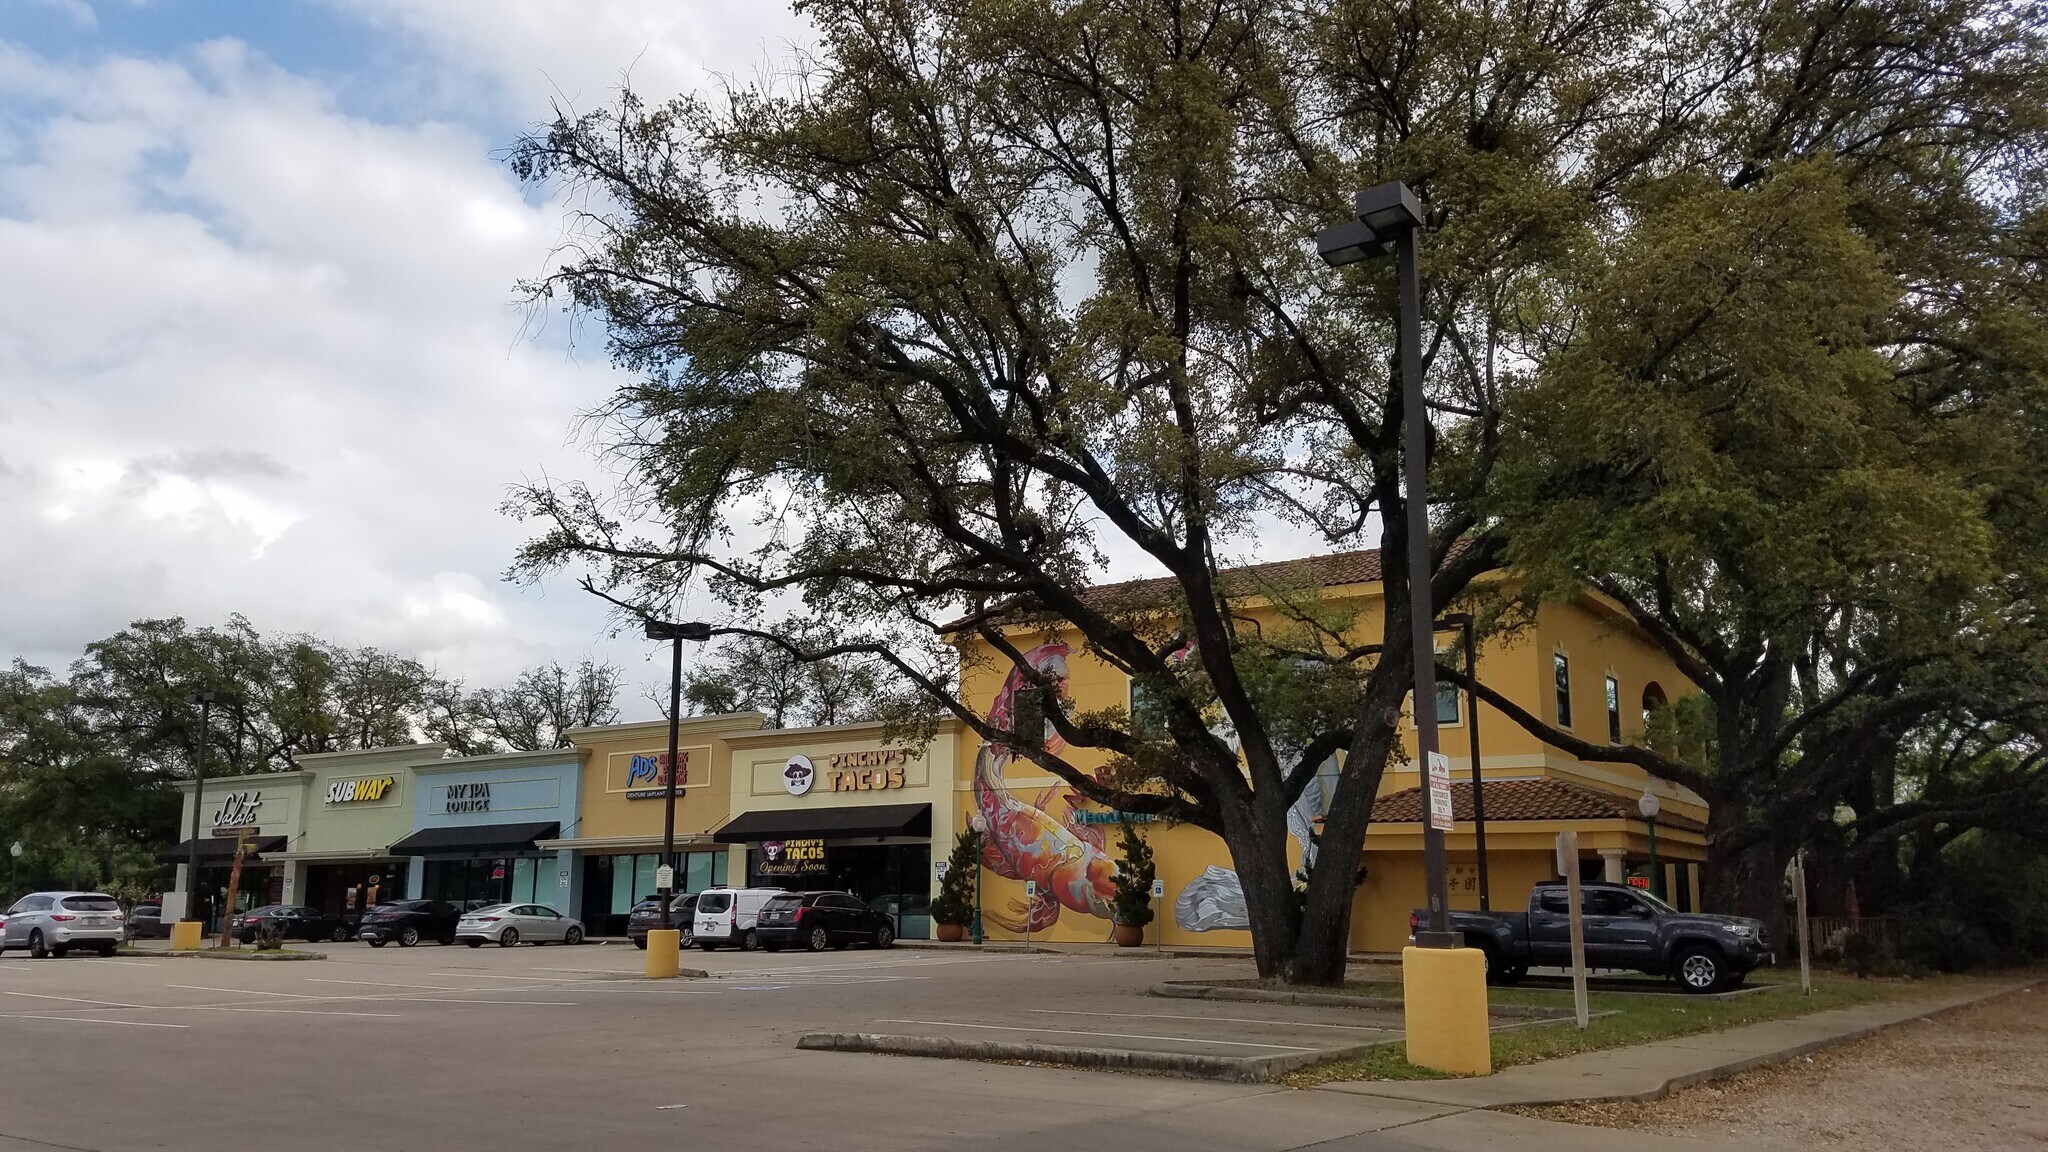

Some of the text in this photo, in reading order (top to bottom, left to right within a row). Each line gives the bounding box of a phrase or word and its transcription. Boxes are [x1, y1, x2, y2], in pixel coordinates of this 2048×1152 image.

[828, 749, 906, 768] PINCHY'S
[626, 754, 657, 787] ADS
[826, 767, 906, 792] TACOS
[324, 776, 395, 804] SUBWAY
[447, 784, 467, 799] MY
[213, 791, 262, 826] Salata
[785, 839, 824, 848] PINCHY'S
[785, 847, 825, 860] TACOS
[760, 860, 827, 874] Opening Soon
